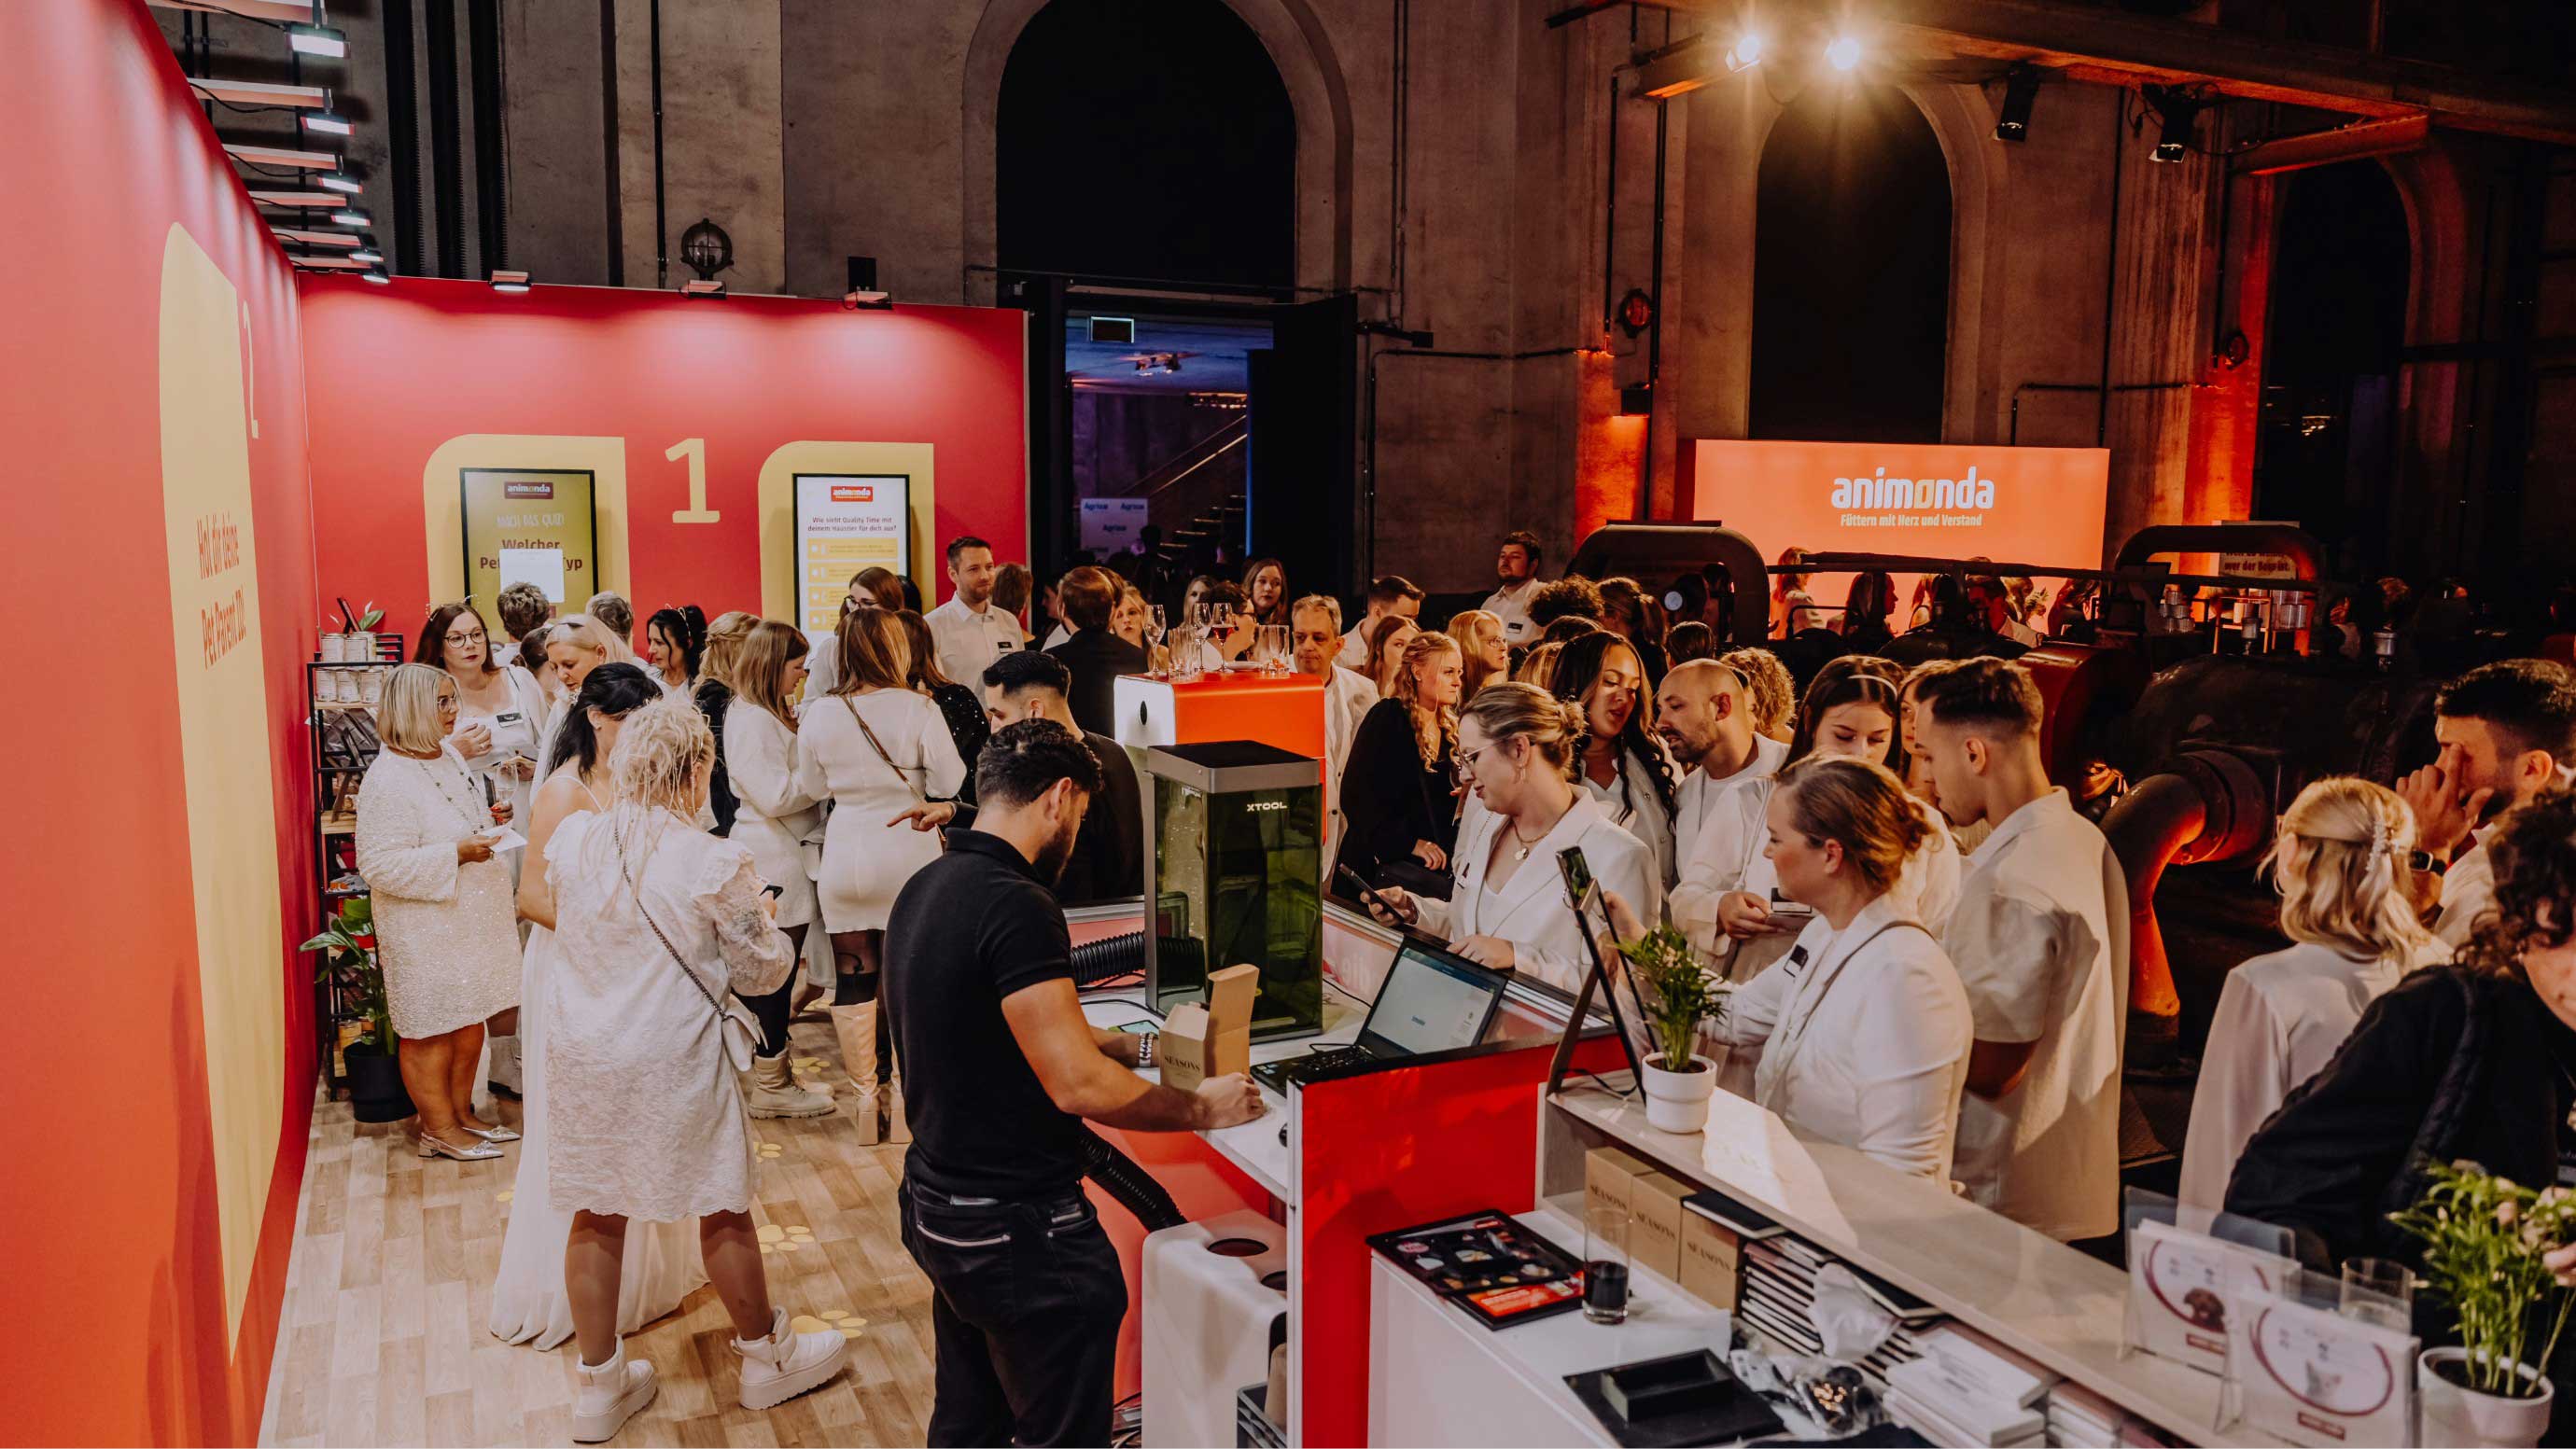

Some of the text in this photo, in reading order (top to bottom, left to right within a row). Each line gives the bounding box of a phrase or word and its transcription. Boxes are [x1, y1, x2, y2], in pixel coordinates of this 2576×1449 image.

[507, 483, 551, 493] animonda
[665, 438, 721, 523] 1
[1831, 466, 1995, 509] animonda
[1841, 513, 1982, 526] Füttern mit Herz und Verstand
[197, 514, 213, 580] Hol
[212, 512, 222, 575] dir
[501, 538, 560, 549] Welcher
[562, 557, 583, 571] yp
[201, 605, 217, 670] Pet
[215, 595, 237, 659] Parent
[1246, 801, 1288, 812] XTOOL
[1164, 1055, 1201, 1072] SEASONS
[1636, 1211, 1676, 1240] SEASONS
[1687, 1241, 1730, 1271] SEASONS
